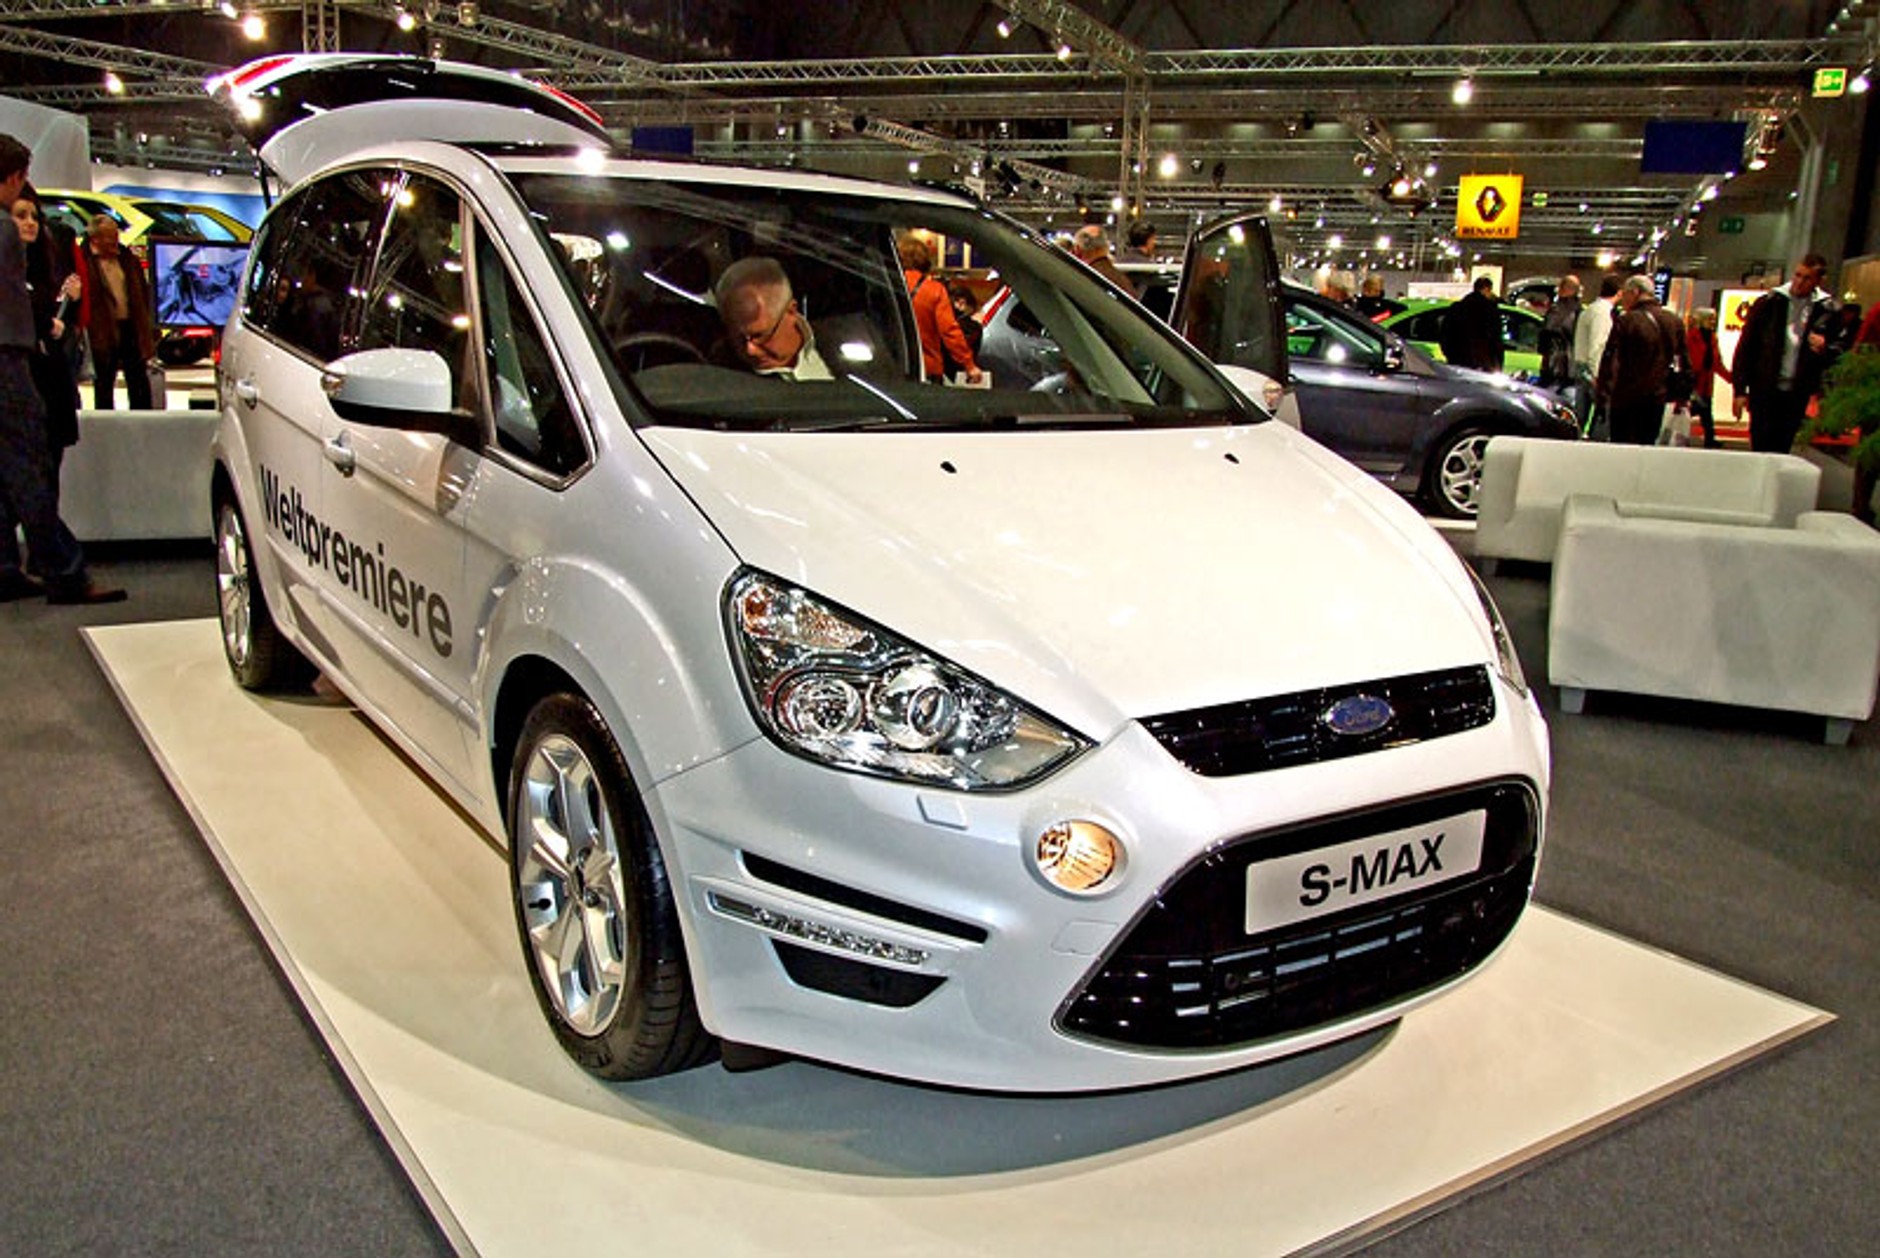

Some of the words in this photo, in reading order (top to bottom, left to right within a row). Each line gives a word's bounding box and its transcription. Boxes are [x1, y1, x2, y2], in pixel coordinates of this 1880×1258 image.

[260, 464, 453, 657] Weltpremiere
[1341, 702, 1384, 727] Ford
[1300, 834, 1445, 906] S-MAX
